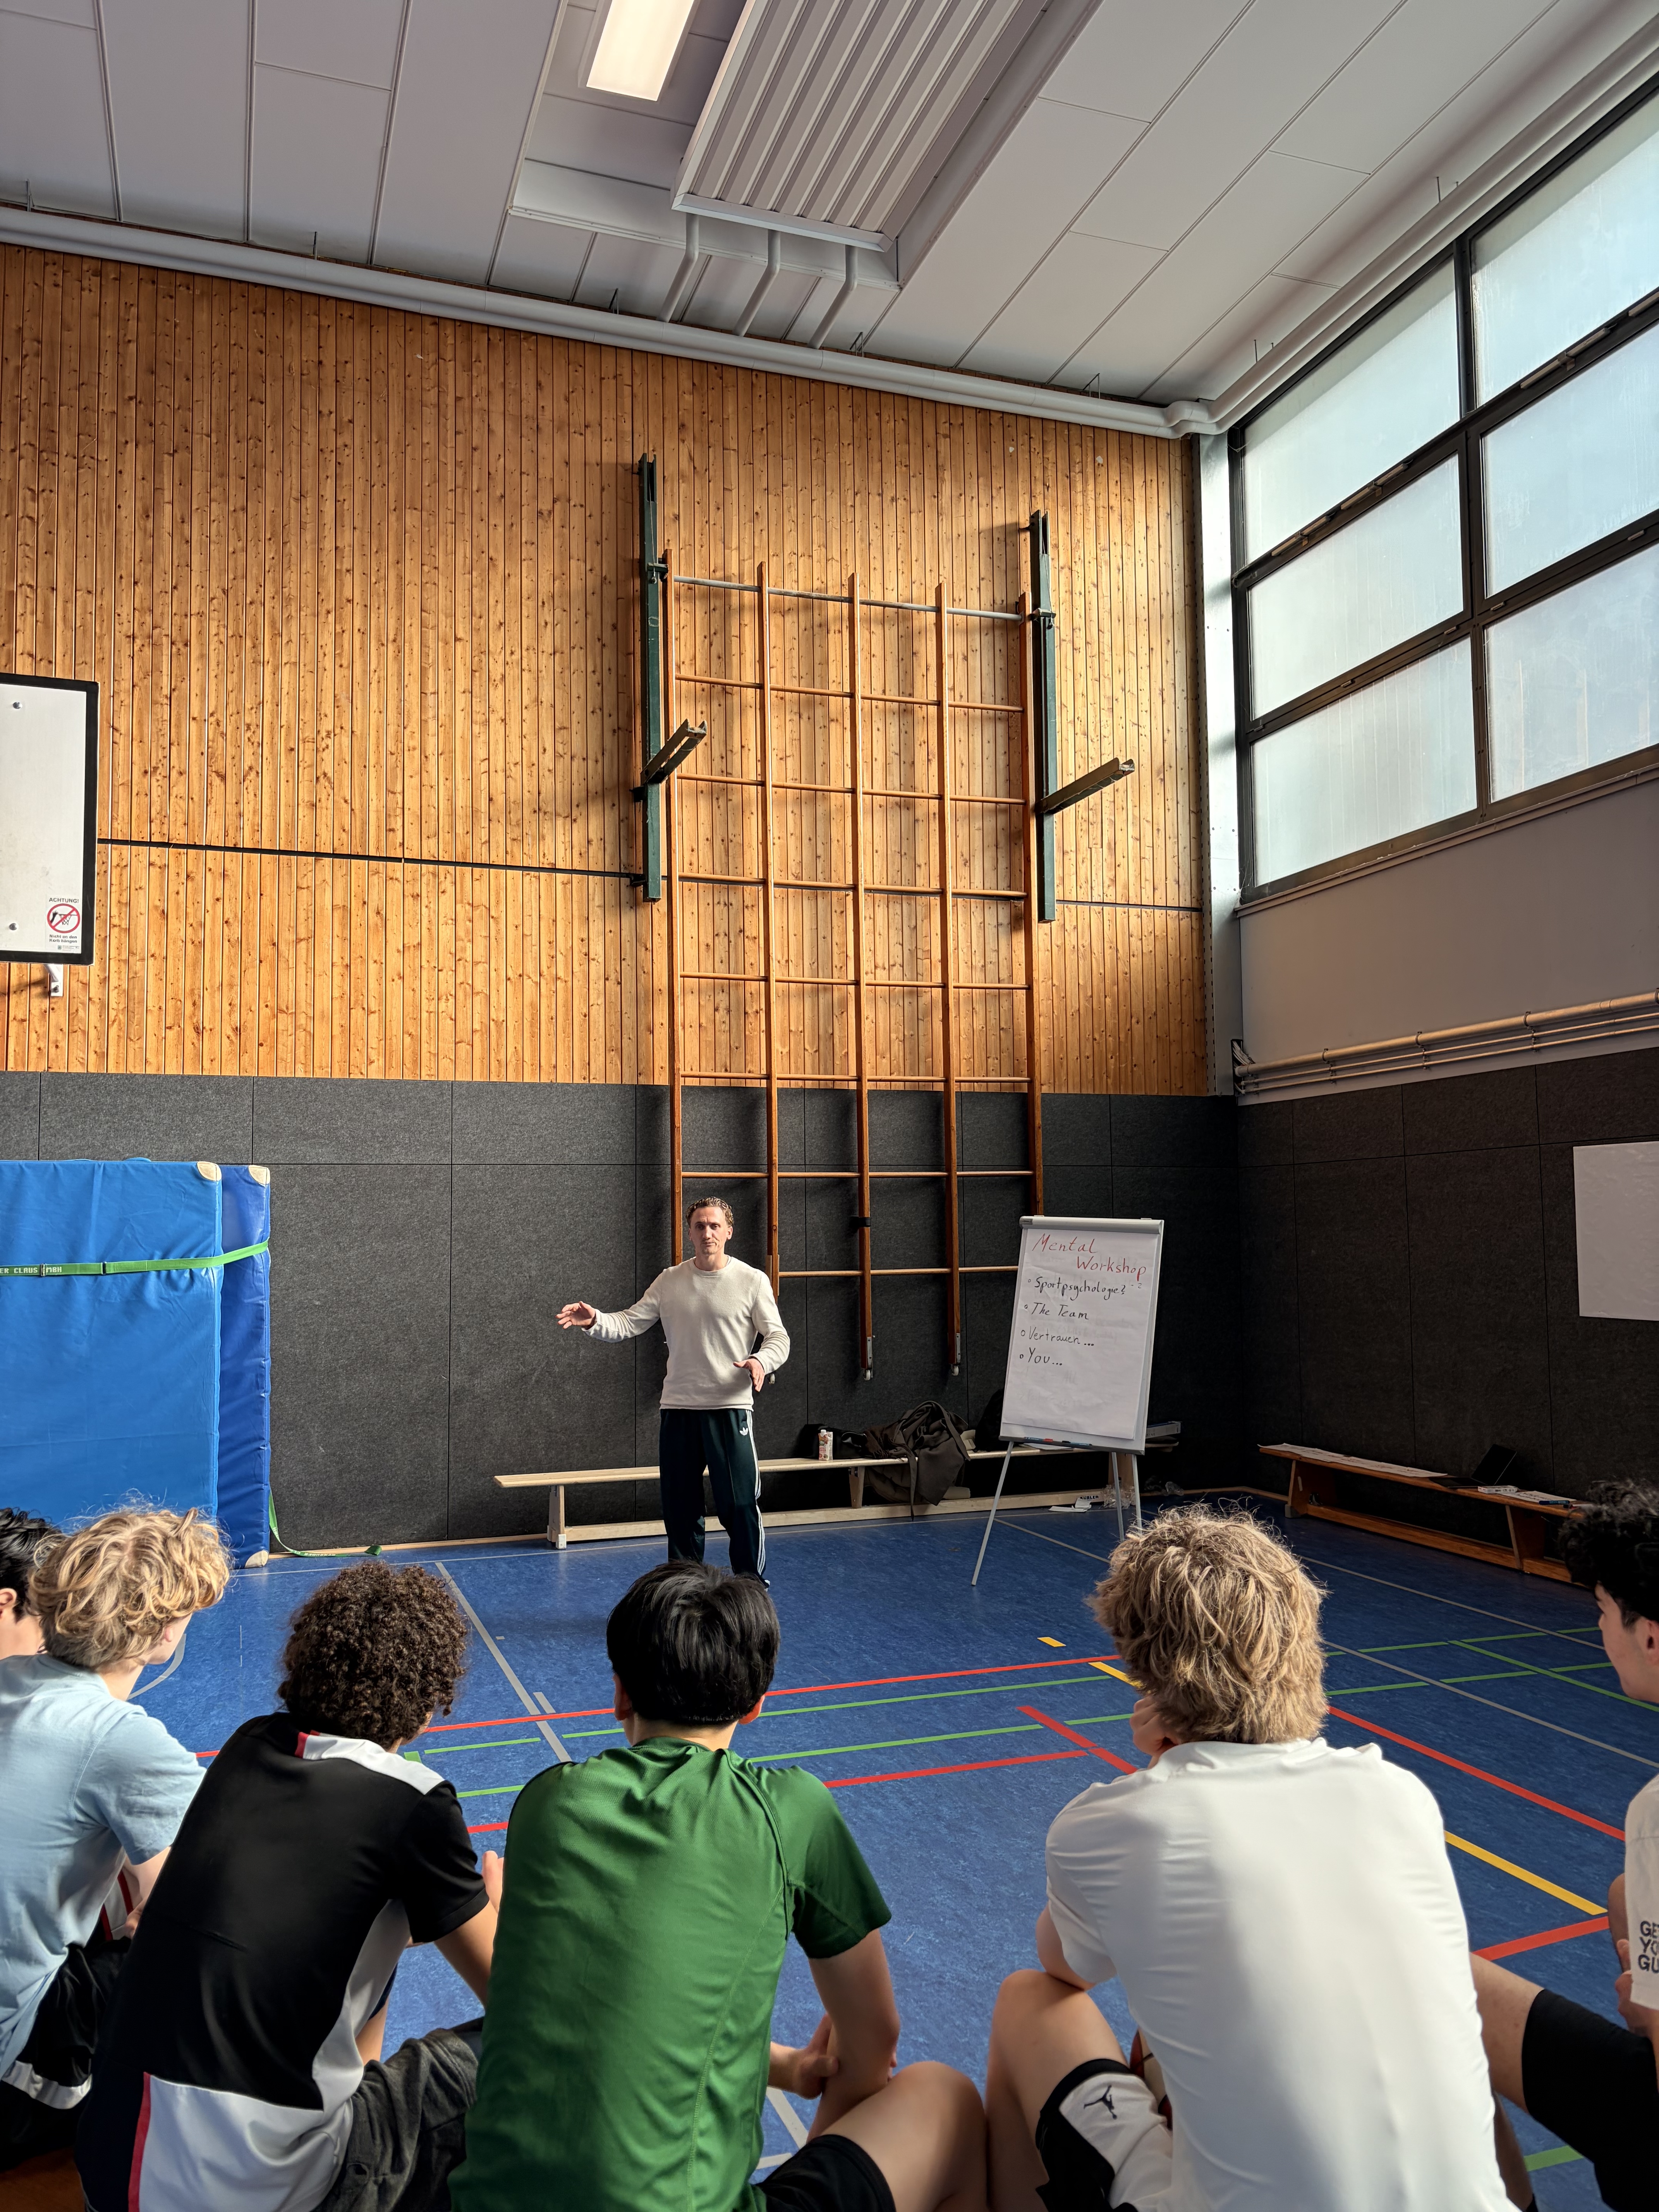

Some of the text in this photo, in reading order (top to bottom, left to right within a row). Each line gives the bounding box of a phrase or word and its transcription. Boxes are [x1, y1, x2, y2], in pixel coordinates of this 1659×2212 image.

[1032, 1233, 1098, 1253] Mental
[1077, 1256, 1146, 1282] Workshop
[1034, 1276, 1125, 1301] Sportpsychologie?
[1031, 1302, 1089, 1320] The Team
[1640, 1920, 1659, 1939] GE
